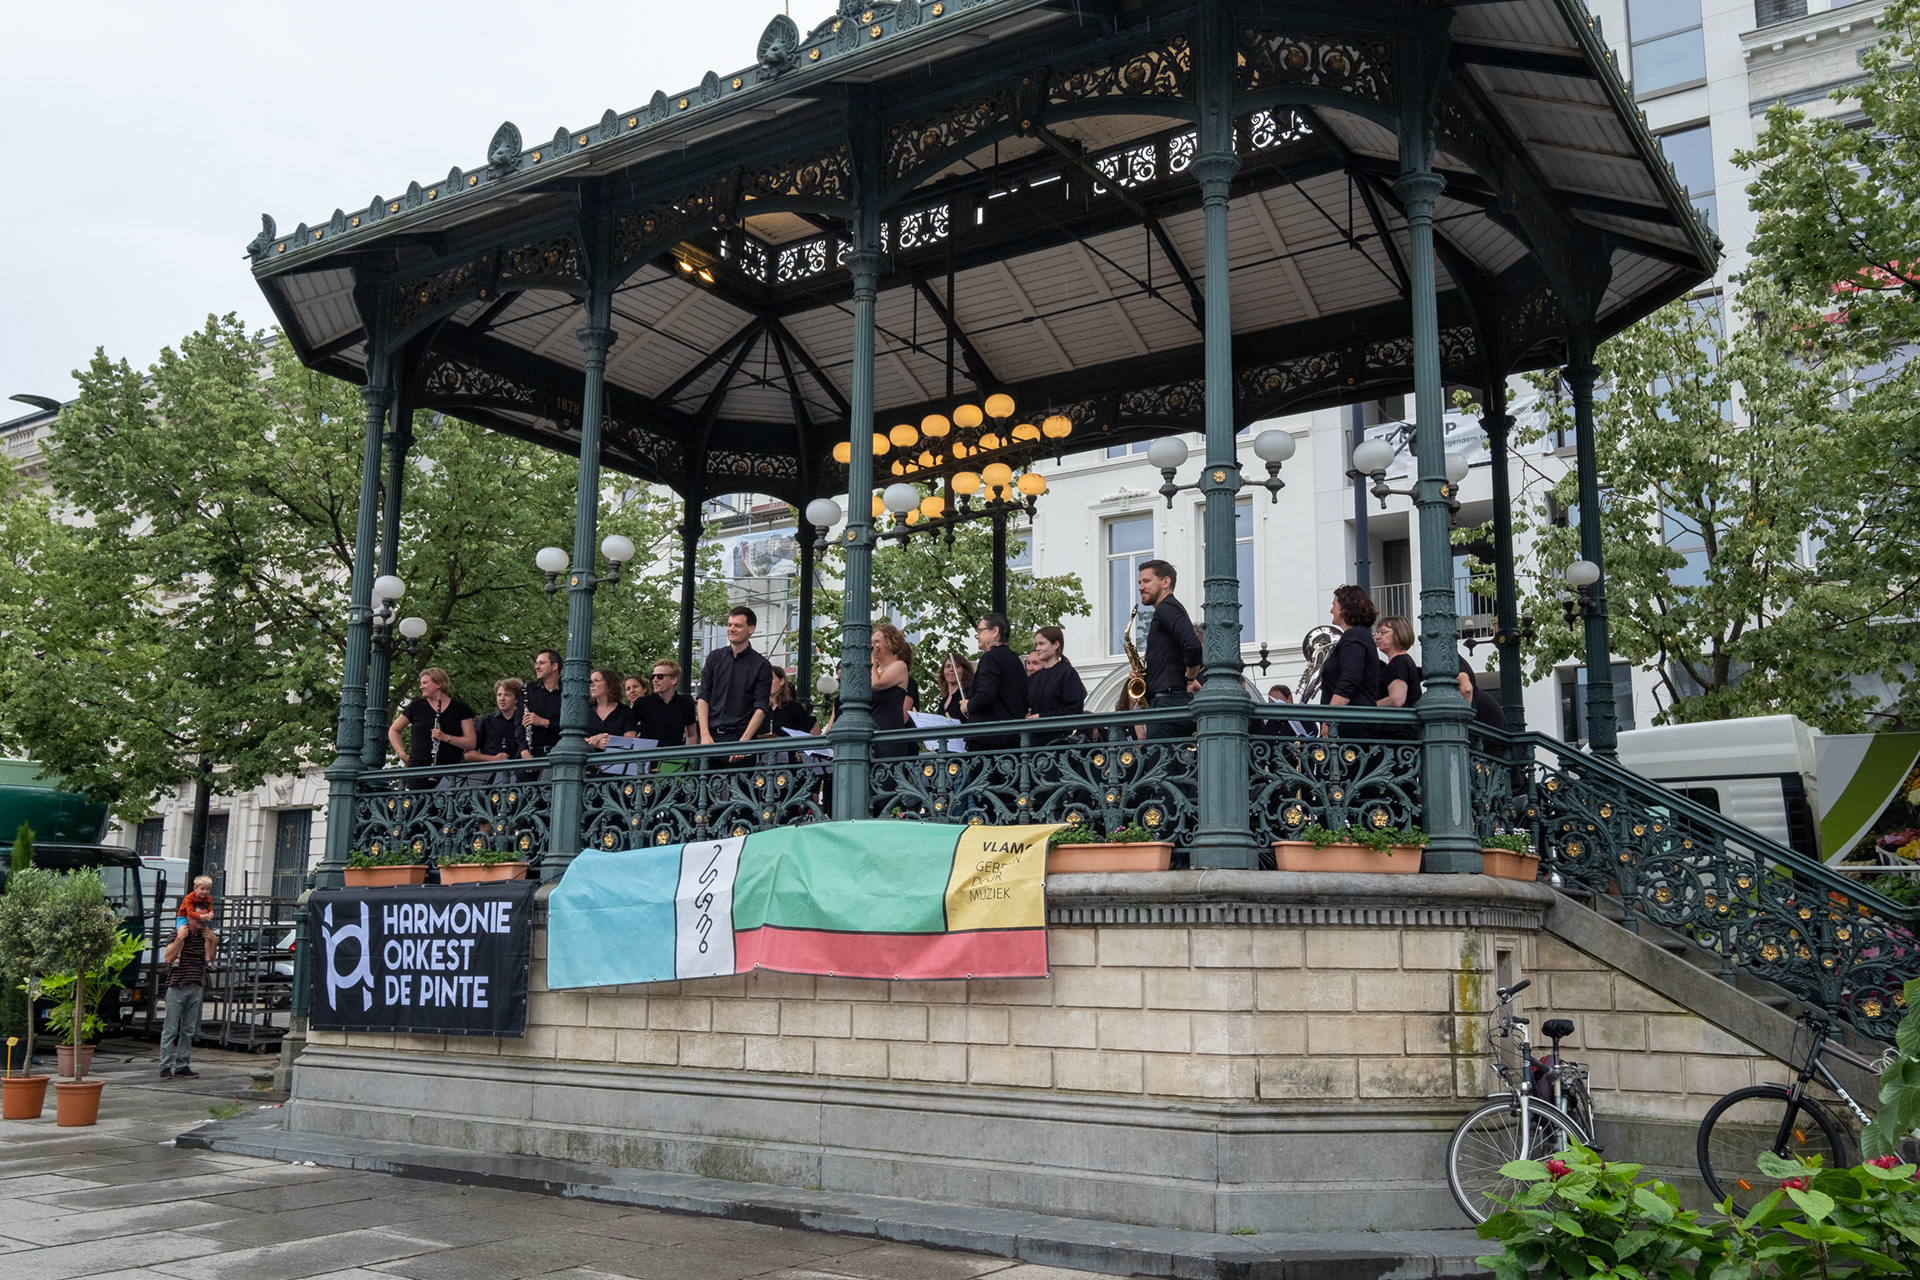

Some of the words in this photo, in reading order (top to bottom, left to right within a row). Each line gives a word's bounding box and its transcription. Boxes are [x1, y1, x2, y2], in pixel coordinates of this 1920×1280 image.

[557, 396, 580, 416] 1878
[969, 887, 1011, 902] MUZIEK
[383, 901, 513, 935] HARMONIE
[383, 939, 475, 971] ORKEST
[385, 975, 412, 1006] DE
[419, 975, 489, 1008] PINTE
